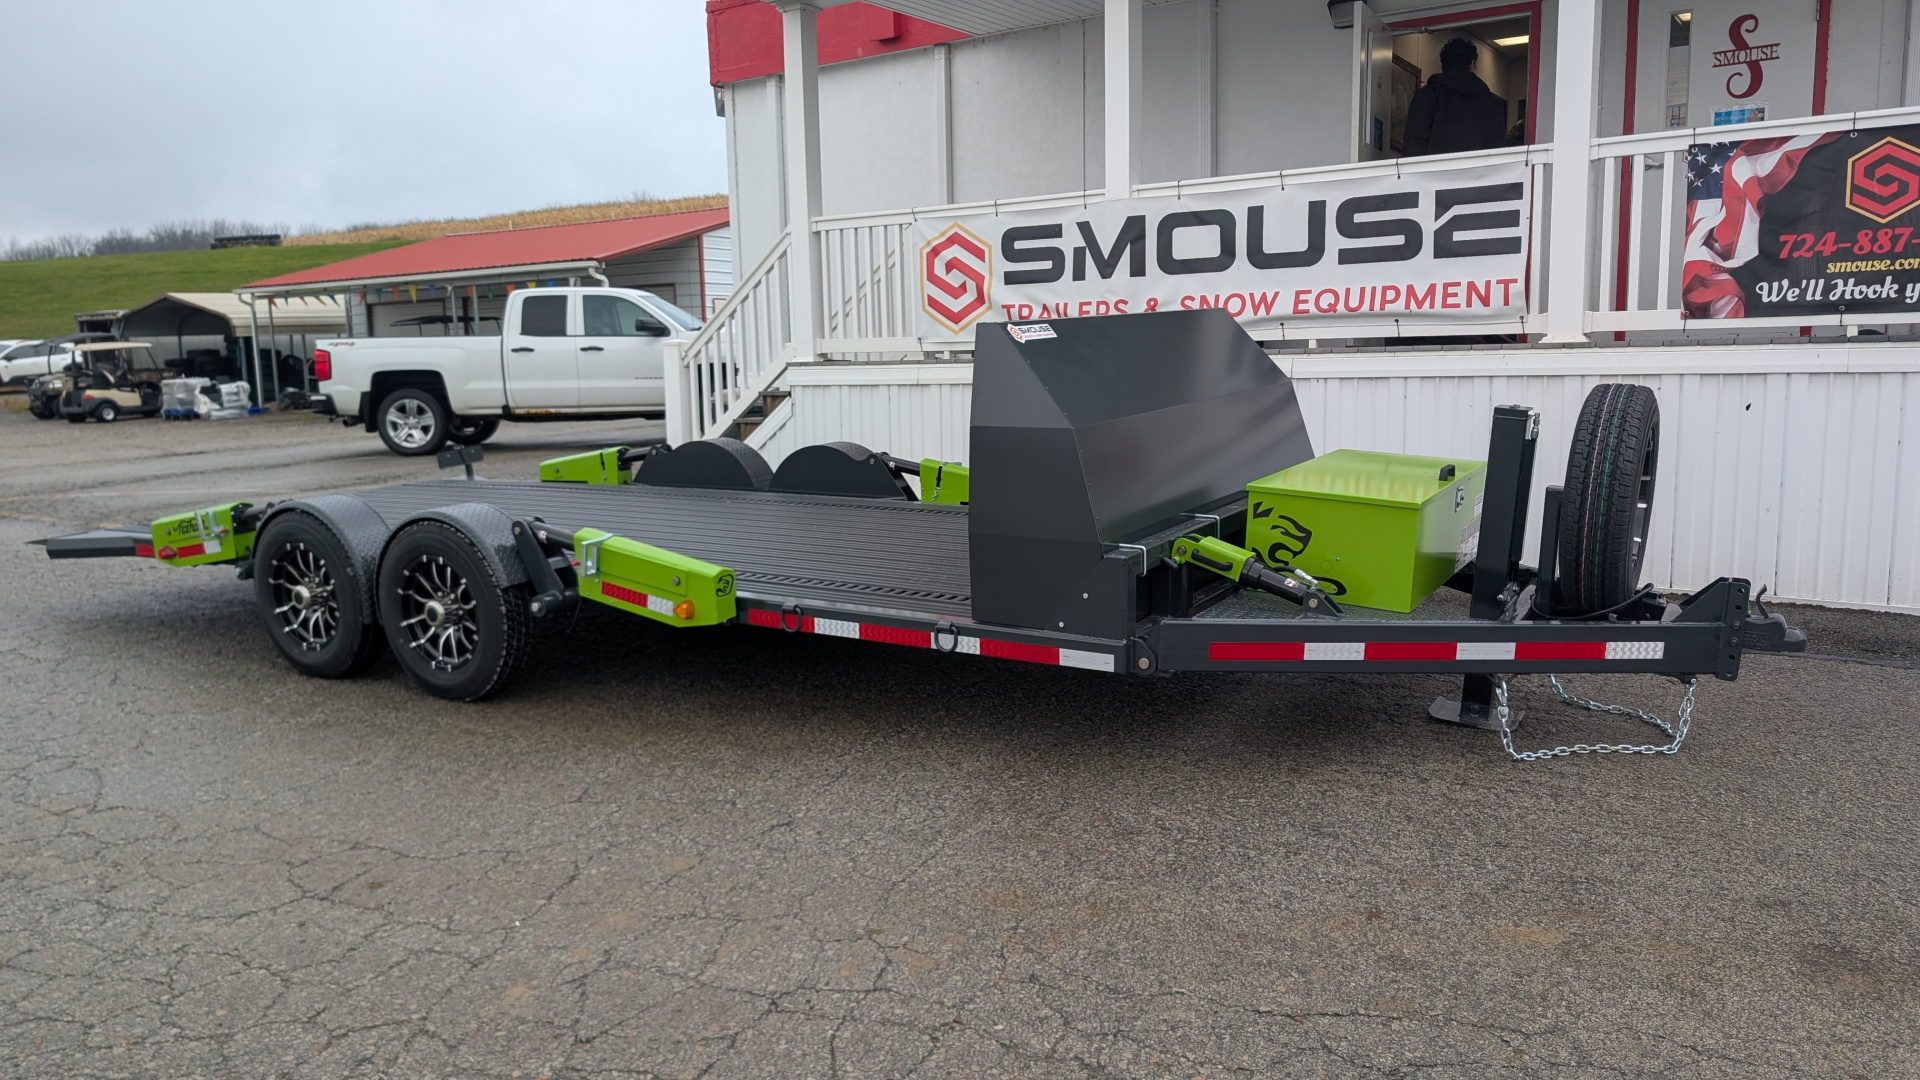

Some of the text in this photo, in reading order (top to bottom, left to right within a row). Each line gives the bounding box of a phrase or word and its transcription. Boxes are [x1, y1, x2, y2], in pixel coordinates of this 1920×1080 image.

[1713, 44, 1780, 67] SMOUSE
[1001, 182, 1524, 286] SMOUSE
[1180, 291, 1281, 318] SNOW
[1292, 278, 1518, 315] EQUIPMENT
[1755, 277, 1825, 303] We'll
[1829, 275, 1899, 301] Hook
